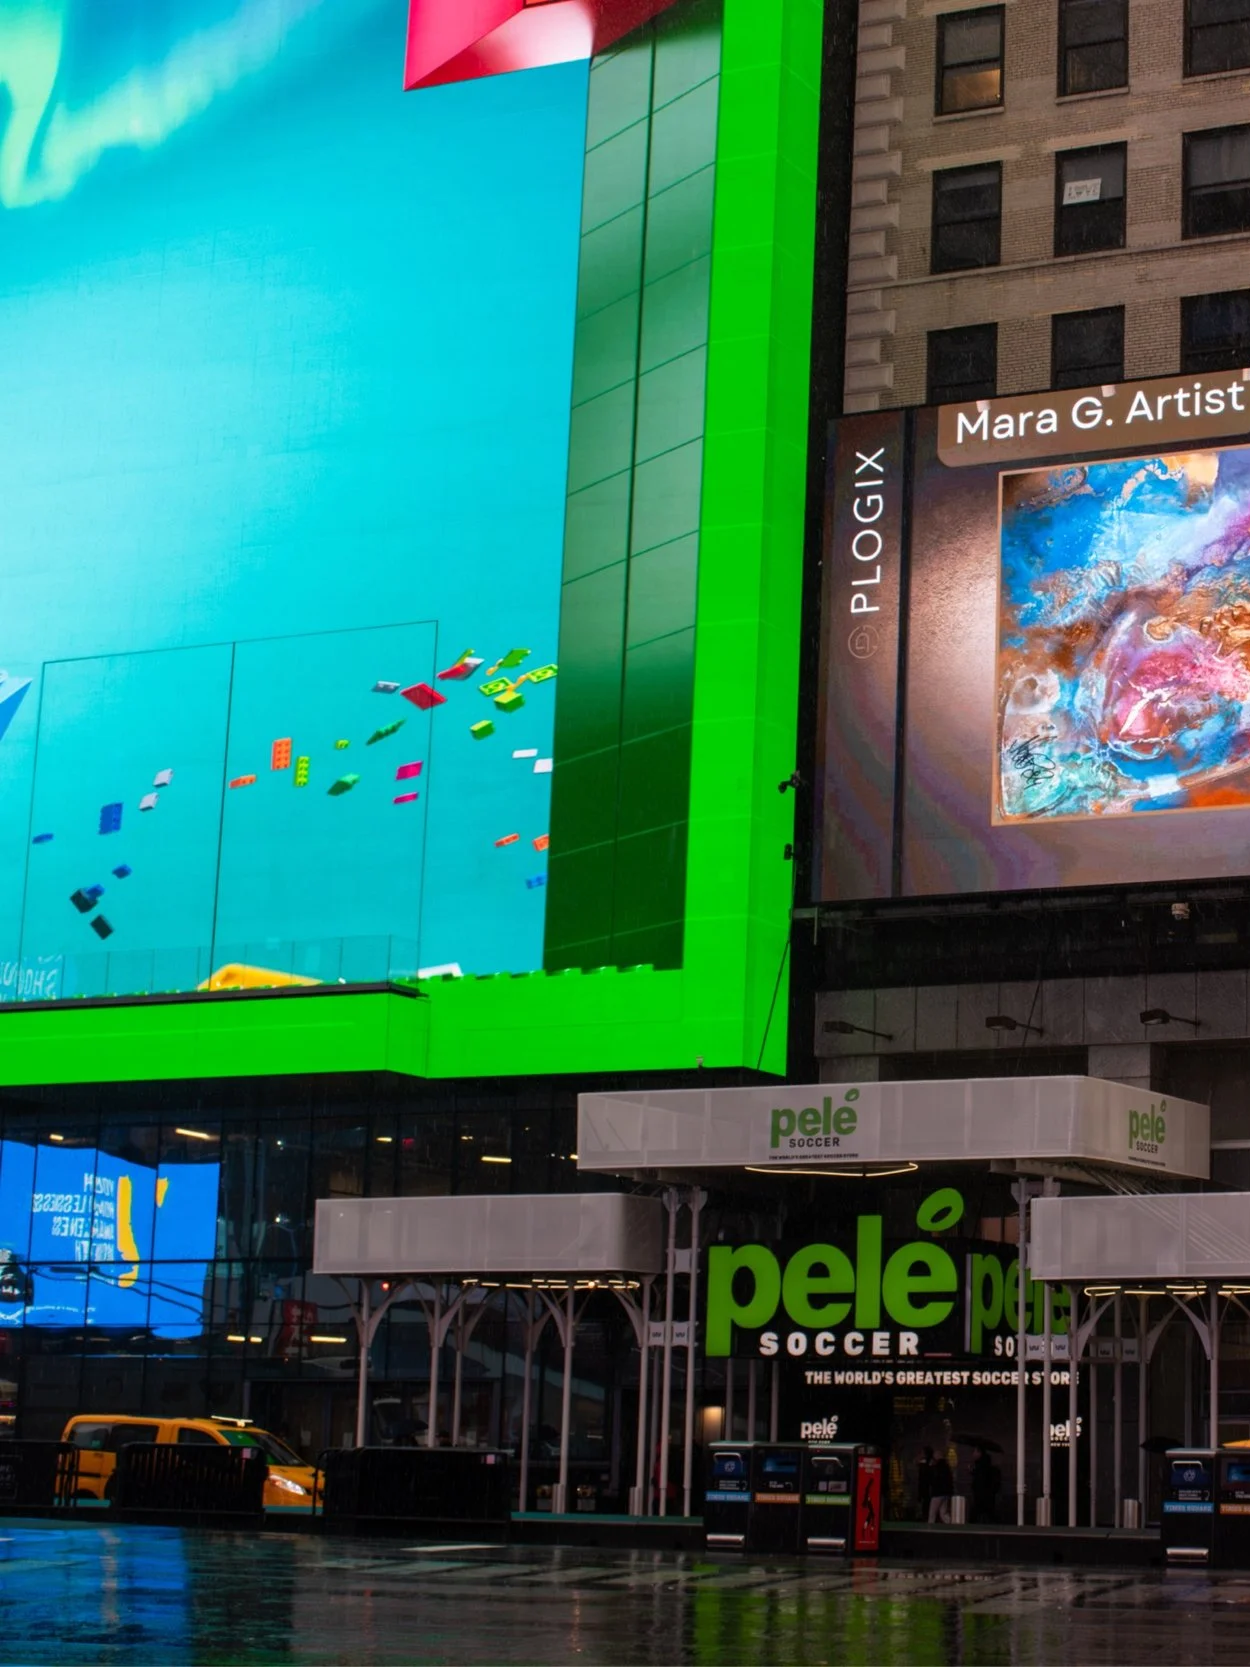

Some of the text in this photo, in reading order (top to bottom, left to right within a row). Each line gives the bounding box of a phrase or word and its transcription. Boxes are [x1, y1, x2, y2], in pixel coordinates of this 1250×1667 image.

[956, 382, 1245, 444] Mara G. Artist
[851, 447, 885, 614] PLOGIX
[770, 1088, 859, 1148] pelé
[789, 1137, 840, 1148] SOCCER
[1128, 1099, 1167, 1149] pelé
[1136, 1141, 1158, 1154] SOCCER
[705, 1187, 965, 1358] pelé
[759, 1331, 920, 1357] SOCCER
[805, 1371, 832, 1385] THE
[834, 1371, 894, 1385] WORLD'S
[896, 1371, 970, 1385] GREATEST
